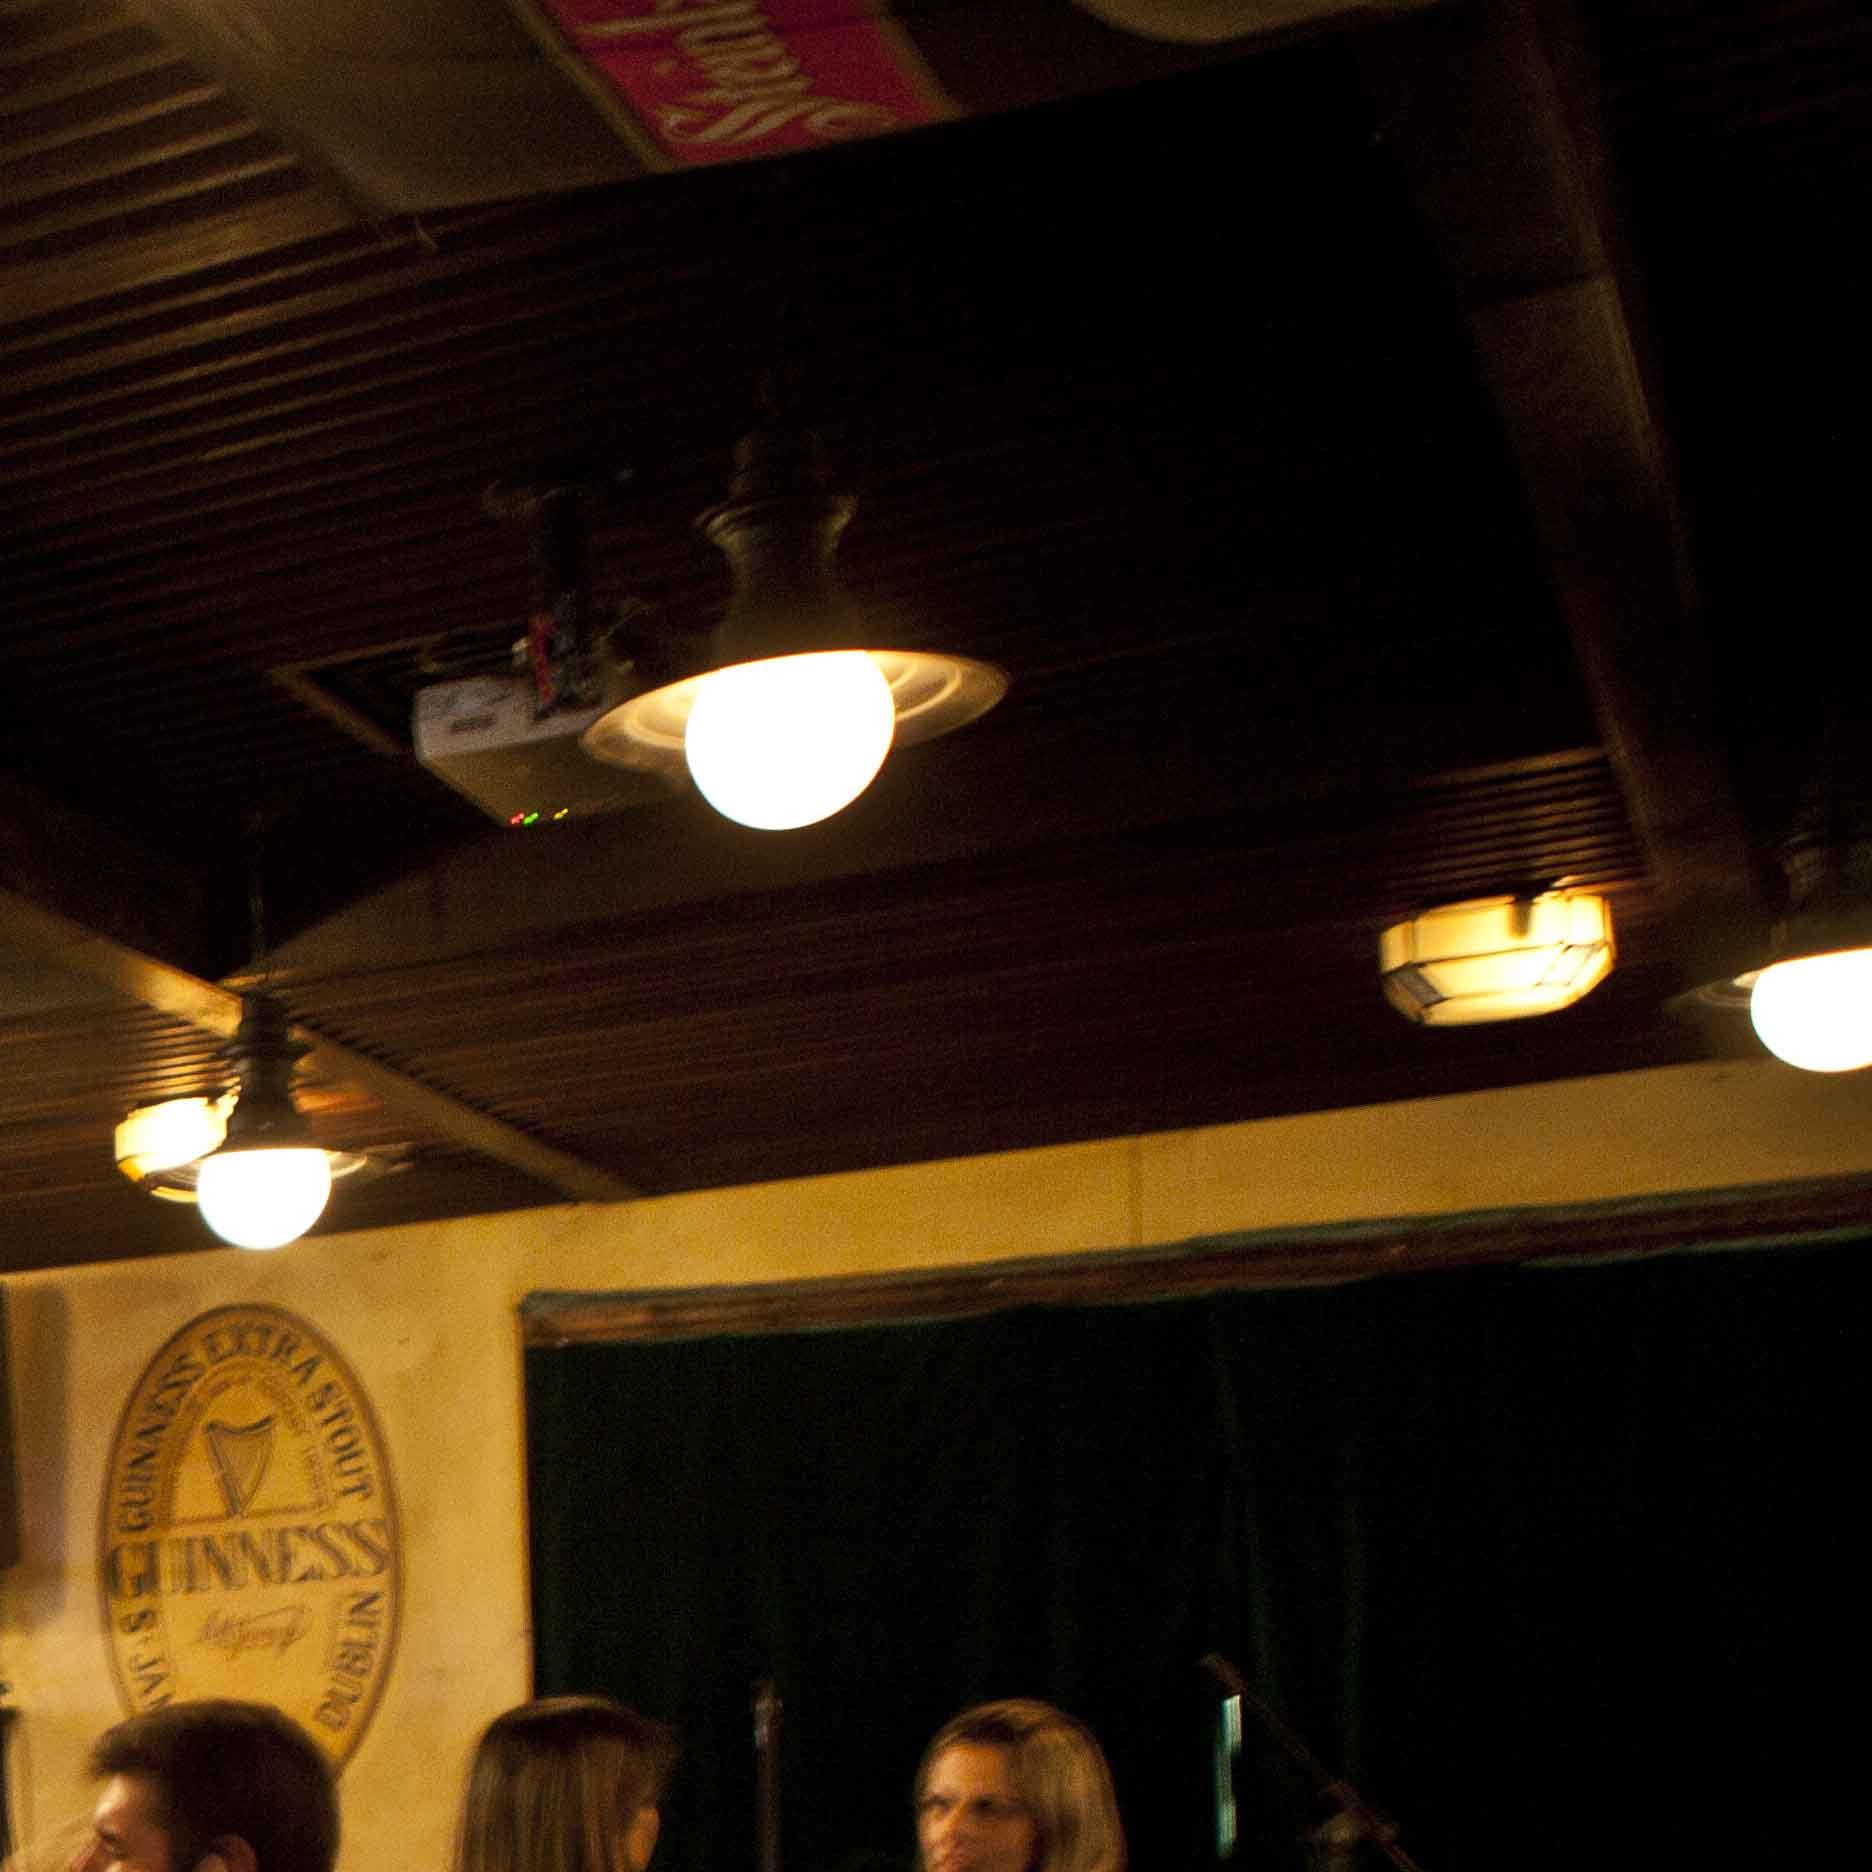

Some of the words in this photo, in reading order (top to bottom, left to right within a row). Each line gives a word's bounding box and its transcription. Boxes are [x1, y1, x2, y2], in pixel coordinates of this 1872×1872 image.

[204, 1326, 322, 1385] EXTRA
[308, 1381, 374, 1501] STOUT
[106, 1520, 387, 1600] GUINNESS
